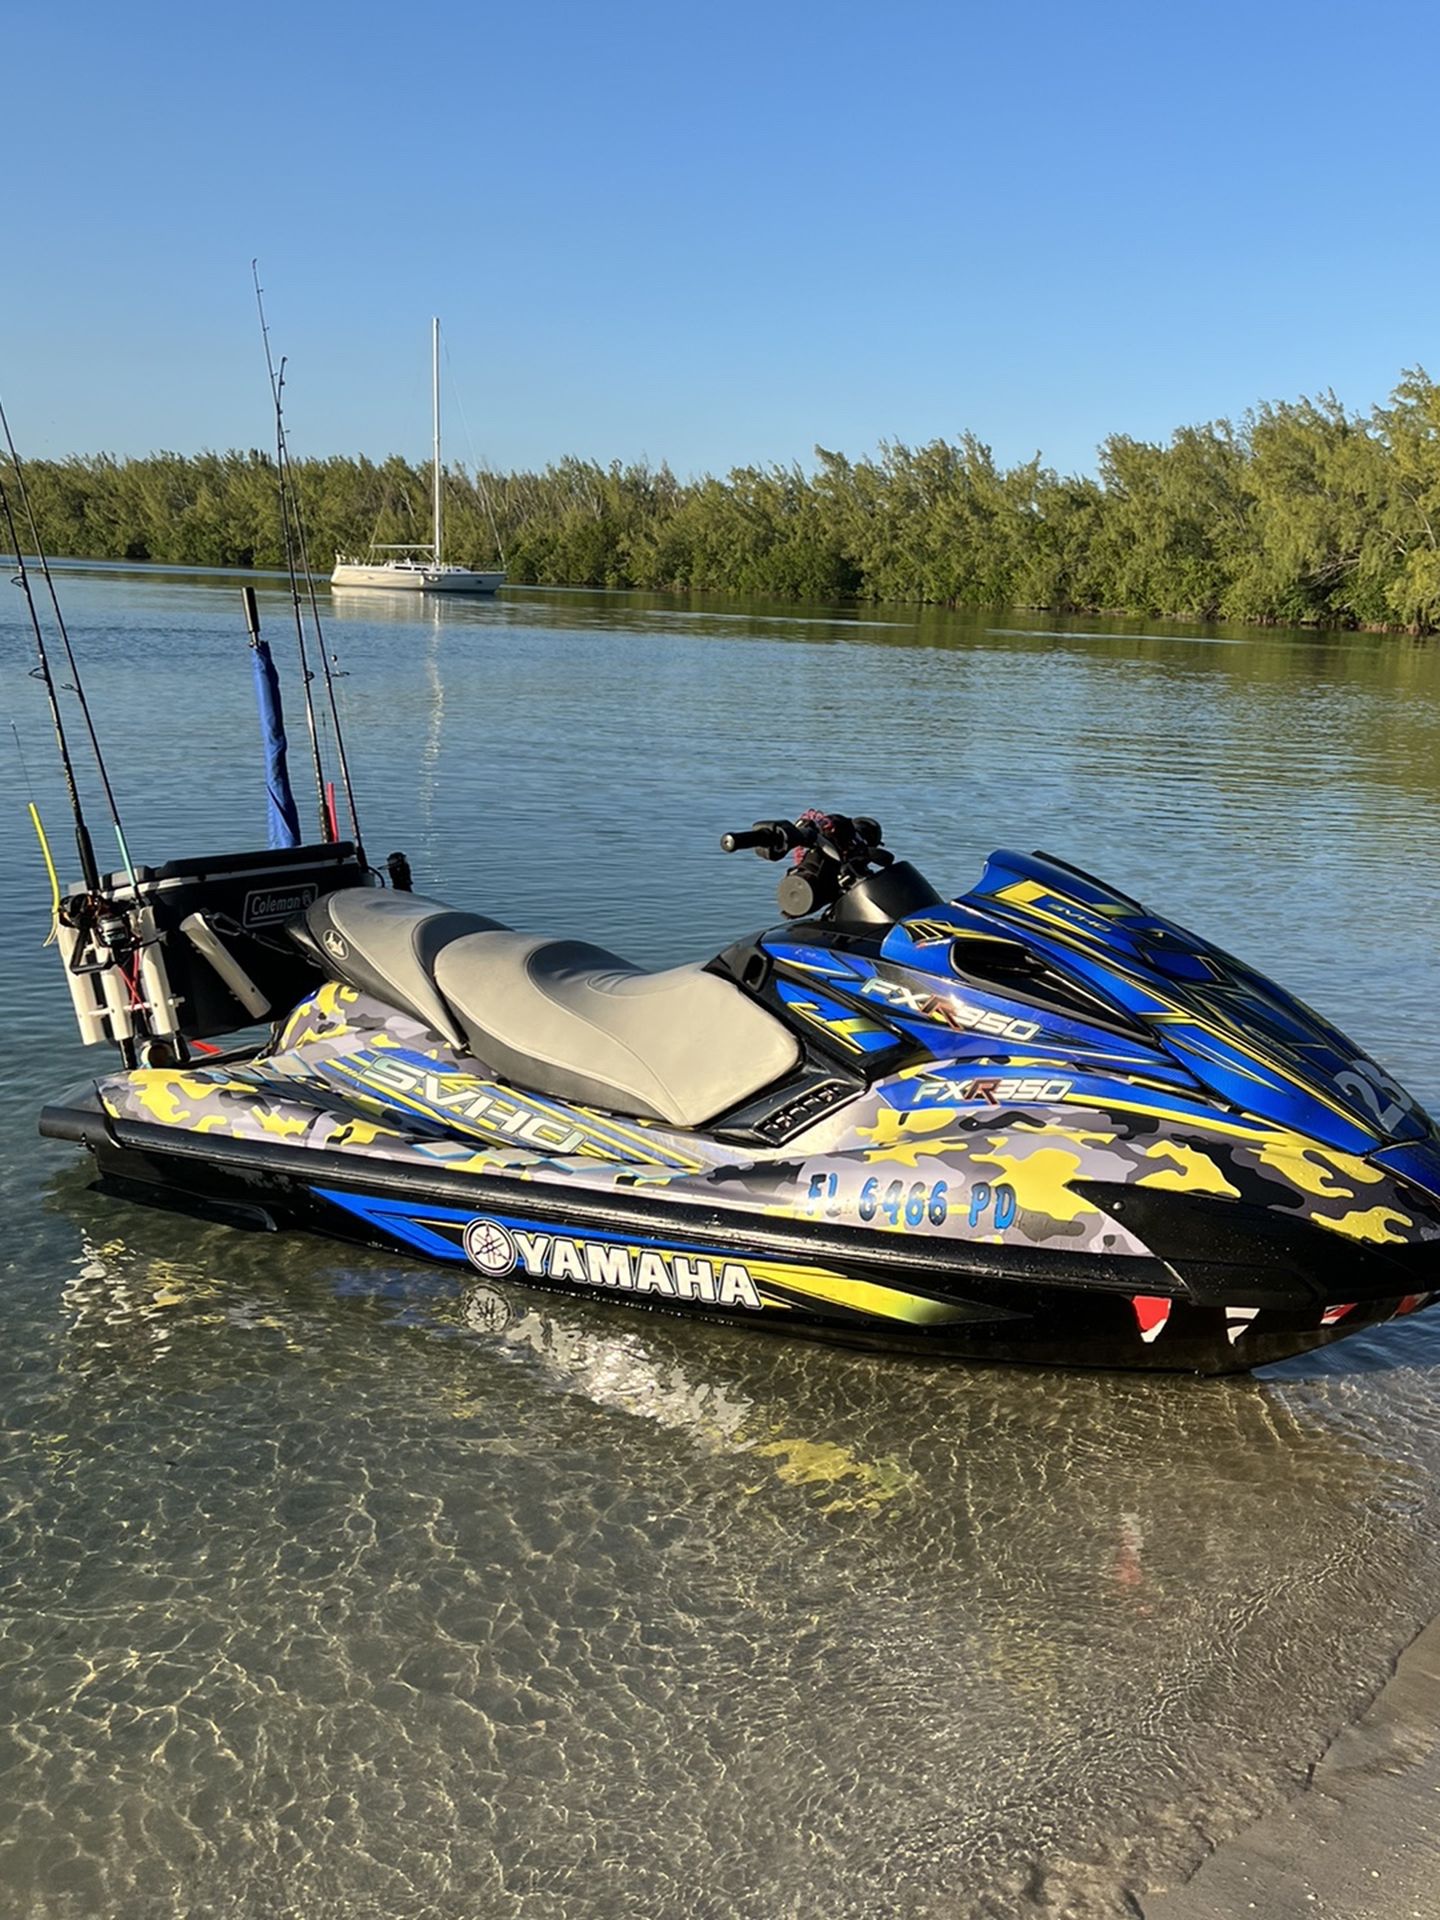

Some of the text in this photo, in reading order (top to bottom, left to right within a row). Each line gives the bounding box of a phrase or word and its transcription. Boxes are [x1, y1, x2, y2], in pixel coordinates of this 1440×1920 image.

[251, 894, 301, 915] Coleman
[860, 977, 1043, 1042] FXR350
[362, 1055, 588, 1154] SVHO
[912, 1077, 1074, 1106] FXR350
[806, 1172, 1017, 1230] FL 6466 PD
[509, 1229, 765, 1310] YAMAHA
